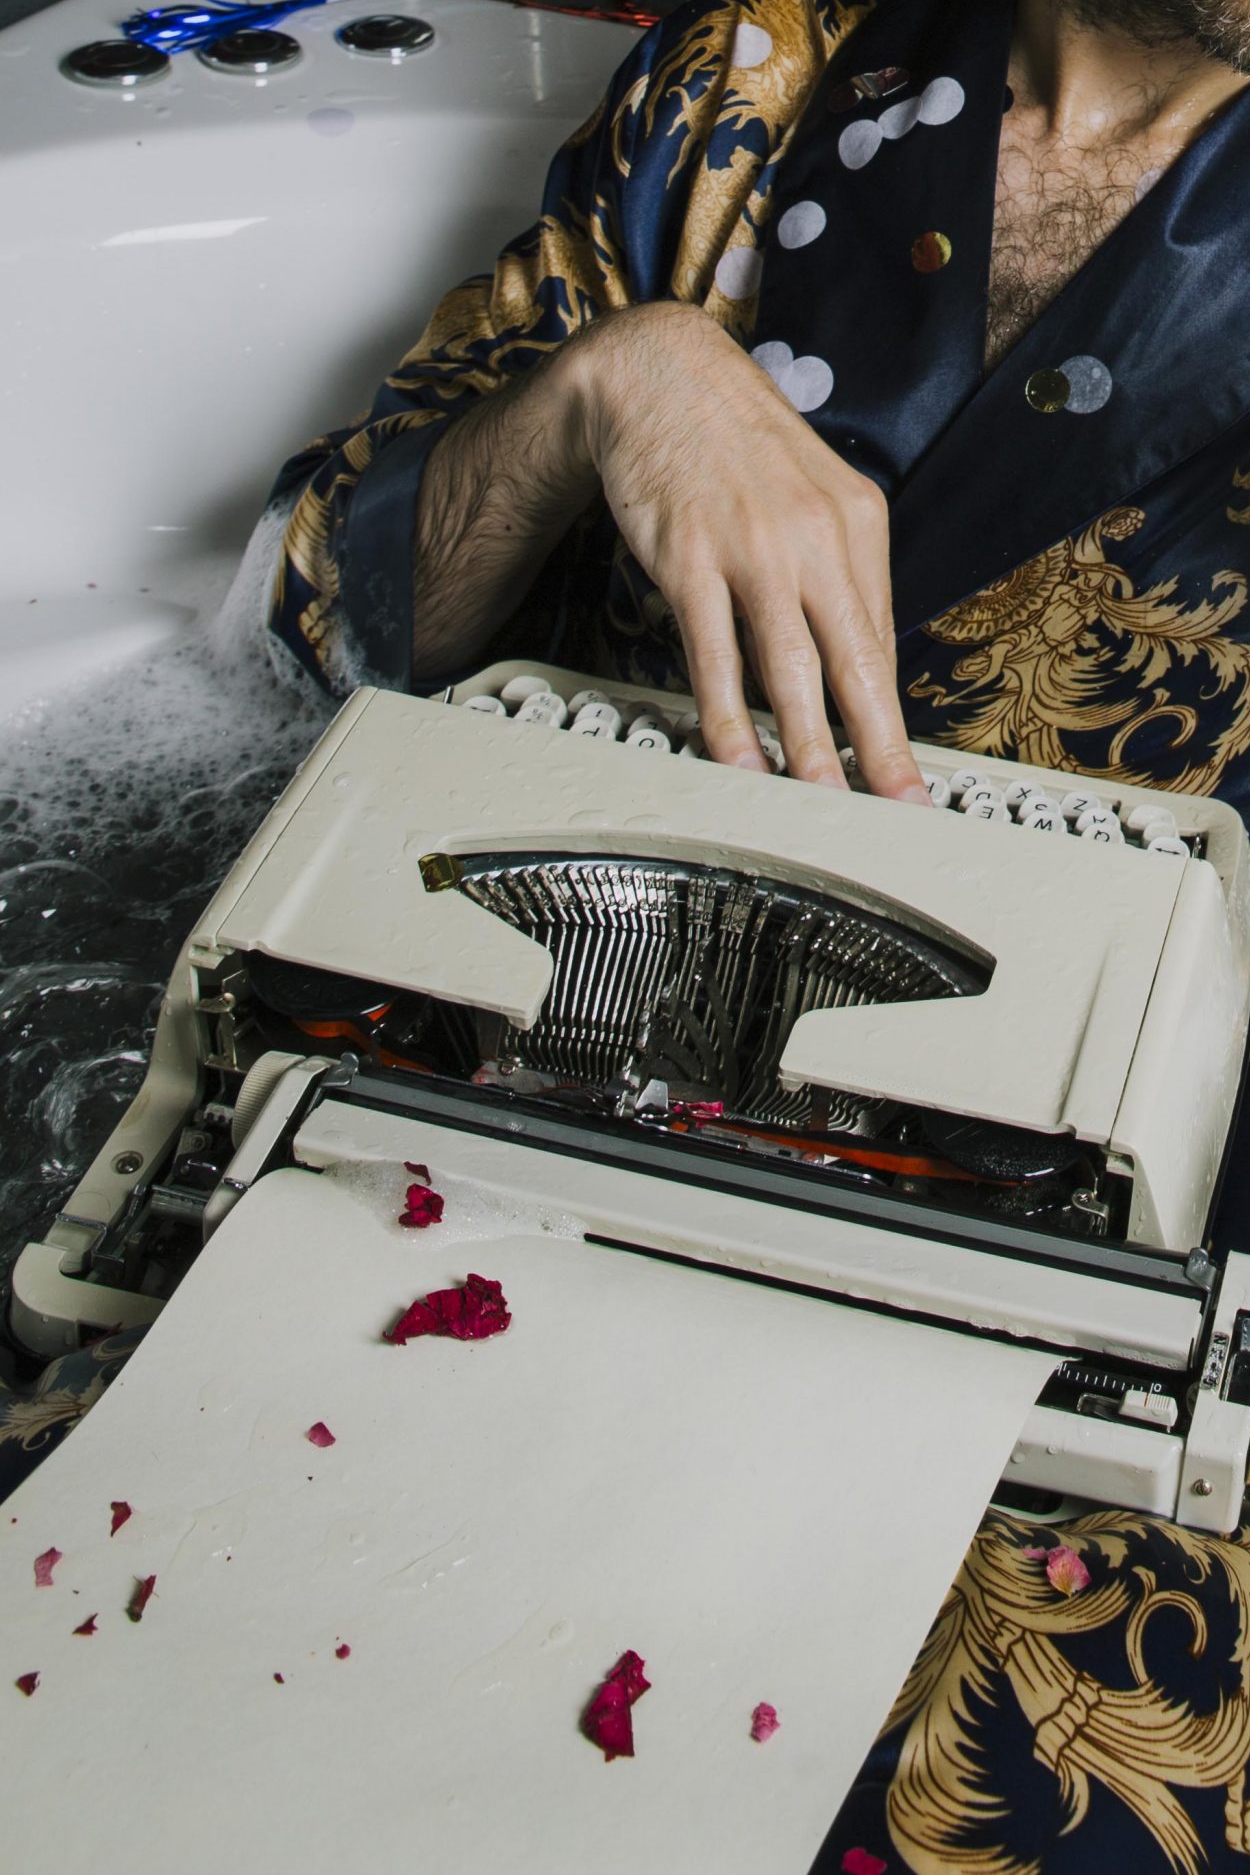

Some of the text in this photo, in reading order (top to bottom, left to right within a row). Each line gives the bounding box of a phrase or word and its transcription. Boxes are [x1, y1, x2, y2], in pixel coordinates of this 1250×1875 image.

[963, 775, 977, 789] C
[1017, 786, 1033, 800] X
[979, 806, 995, 820] E
[1033, 817, 1053, 832] W
